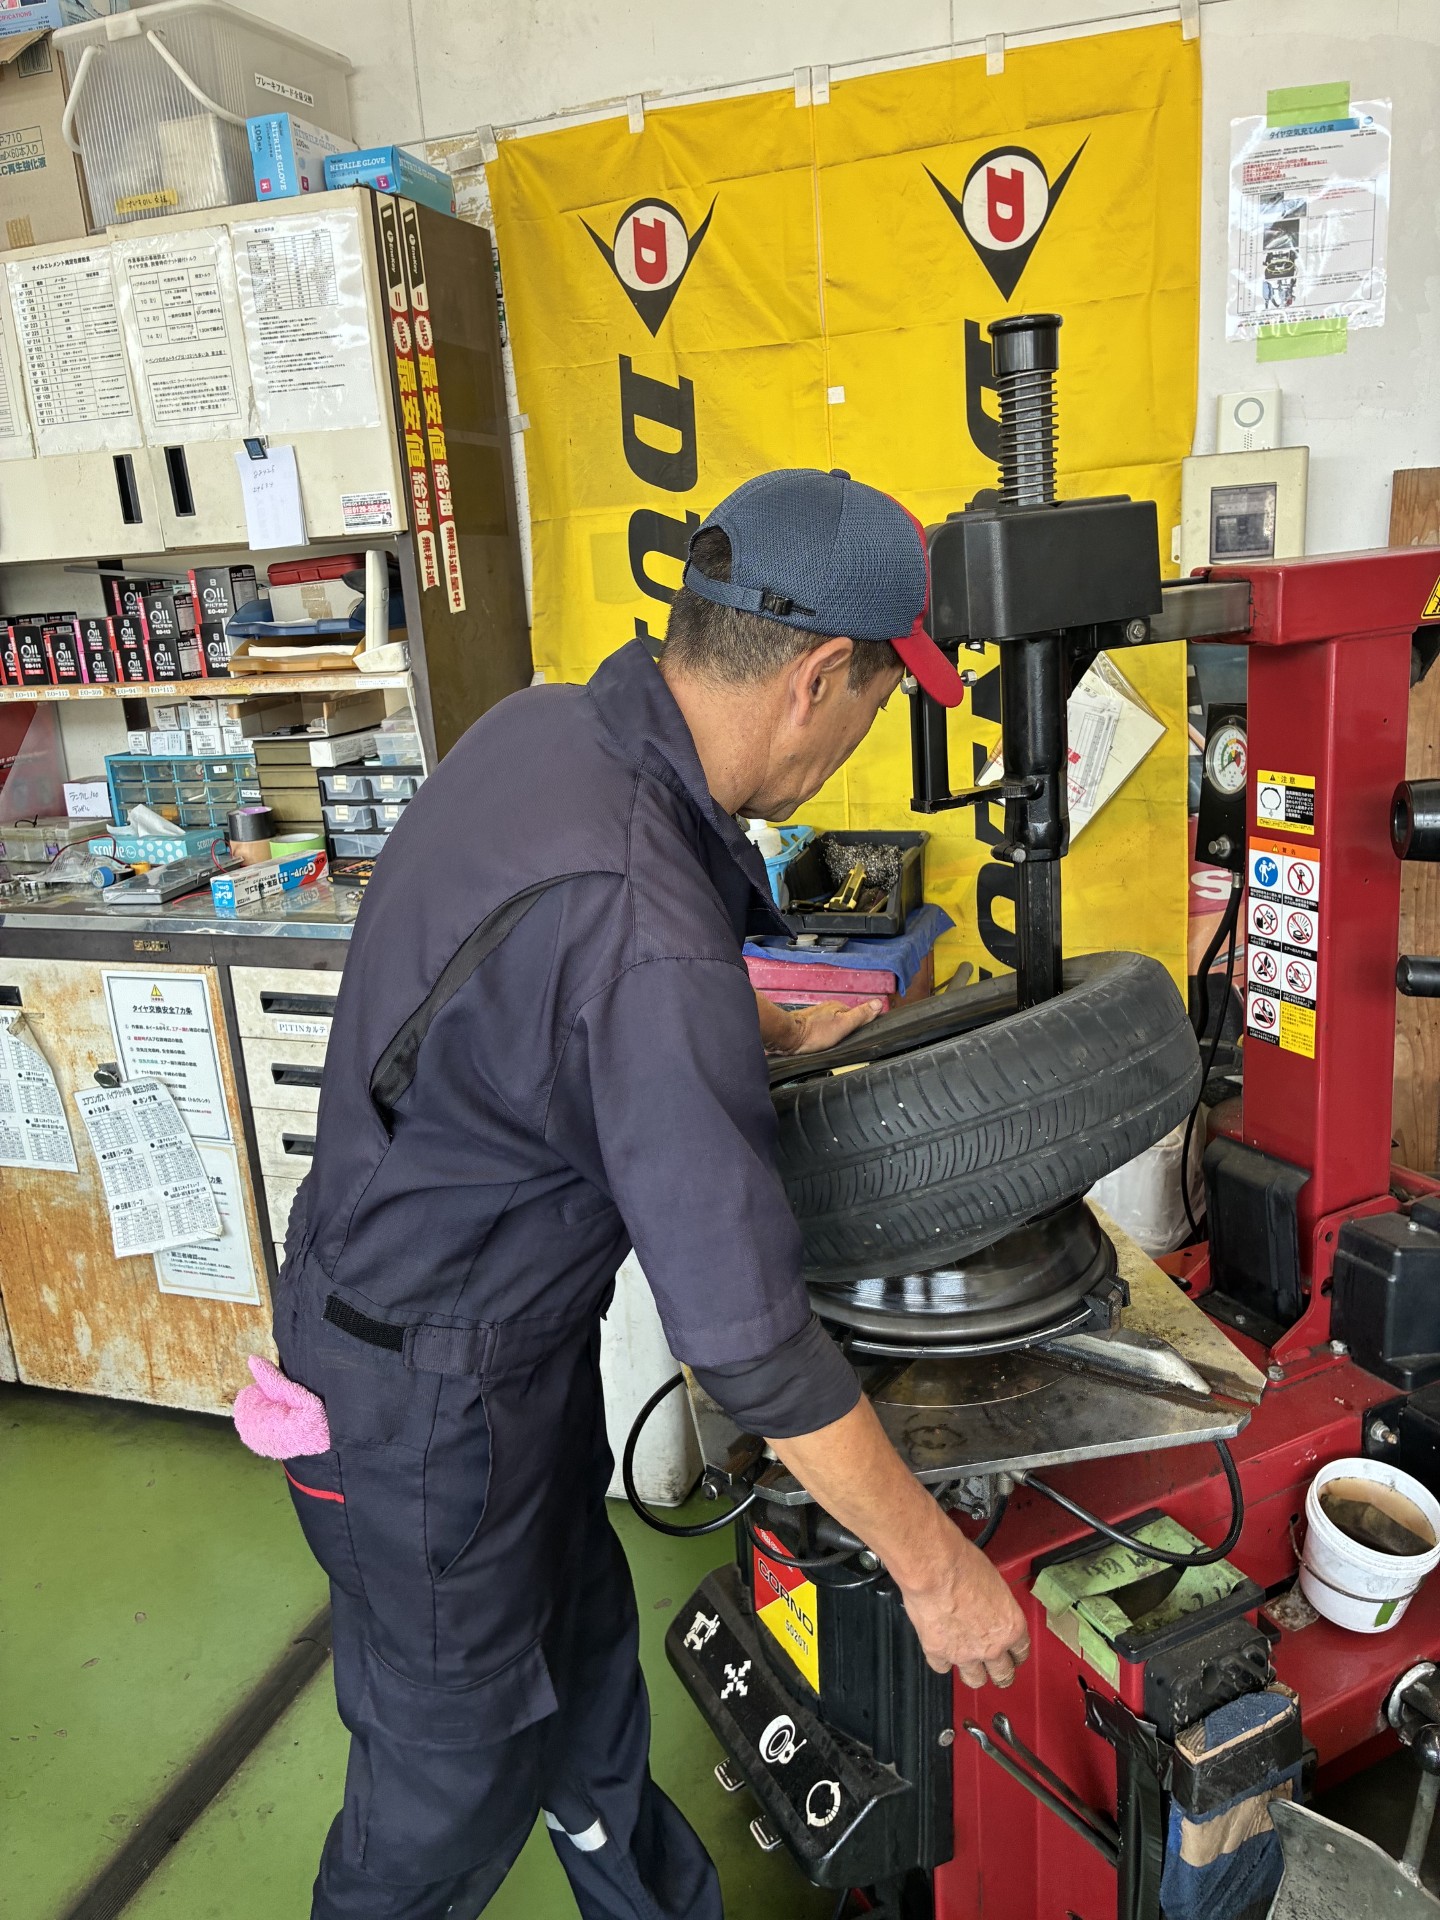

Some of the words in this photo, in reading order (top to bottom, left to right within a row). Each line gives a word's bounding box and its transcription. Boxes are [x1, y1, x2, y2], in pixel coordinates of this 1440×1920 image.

[1269, 124, 1335, 140] タイヤ空気充てん作業
[270, 121, 283, 161] NITRILE
[330, 160, 362, 172] NITRILE
[361, 157, 386, 167] GLOVE
[276, 162, 287, 191] GLOVE
[203, 587, 228, 603] OIL
[150, 609, 173, 624] OIL
[20, 644, 41, 658] OIL
[56, 650, 74, 662] OIL
[154, 652, 176, 667] OIL
[757, 1558, 815, 1638] CORNO
